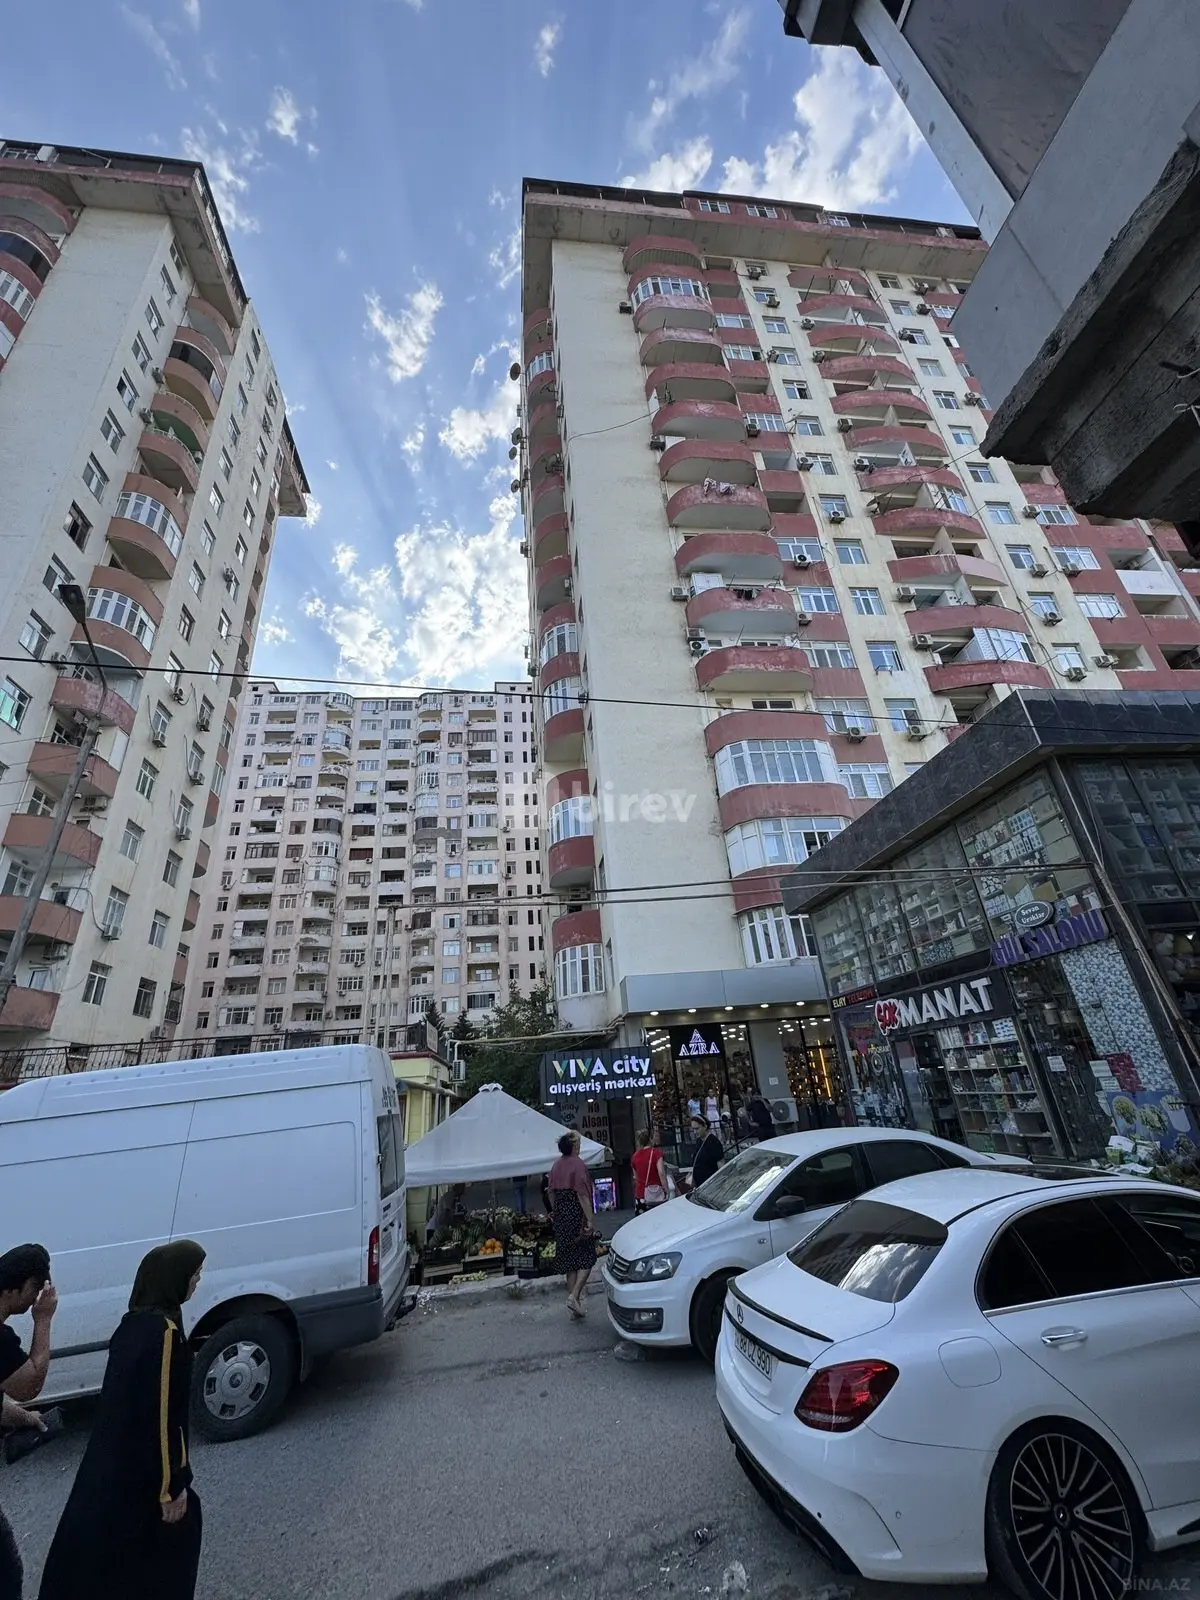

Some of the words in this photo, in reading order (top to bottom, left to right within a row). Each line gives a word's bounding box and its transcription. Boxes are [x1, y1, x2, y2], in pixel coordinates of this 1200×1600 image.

[1024, 908, 1108, 958] SALONU
[899, 976, 994, 1028] MANAT
[679, 1041, 720, 1056] AZRA
[552, 1057, 608, 1079] VIVA
[612, 1054, 650, 1075] city
[549, 1078, 601, 1095] alışveriş
[605, 1073, 656, 1090] mərkəzi
[582, 1116, 609, 1128] Alsan
